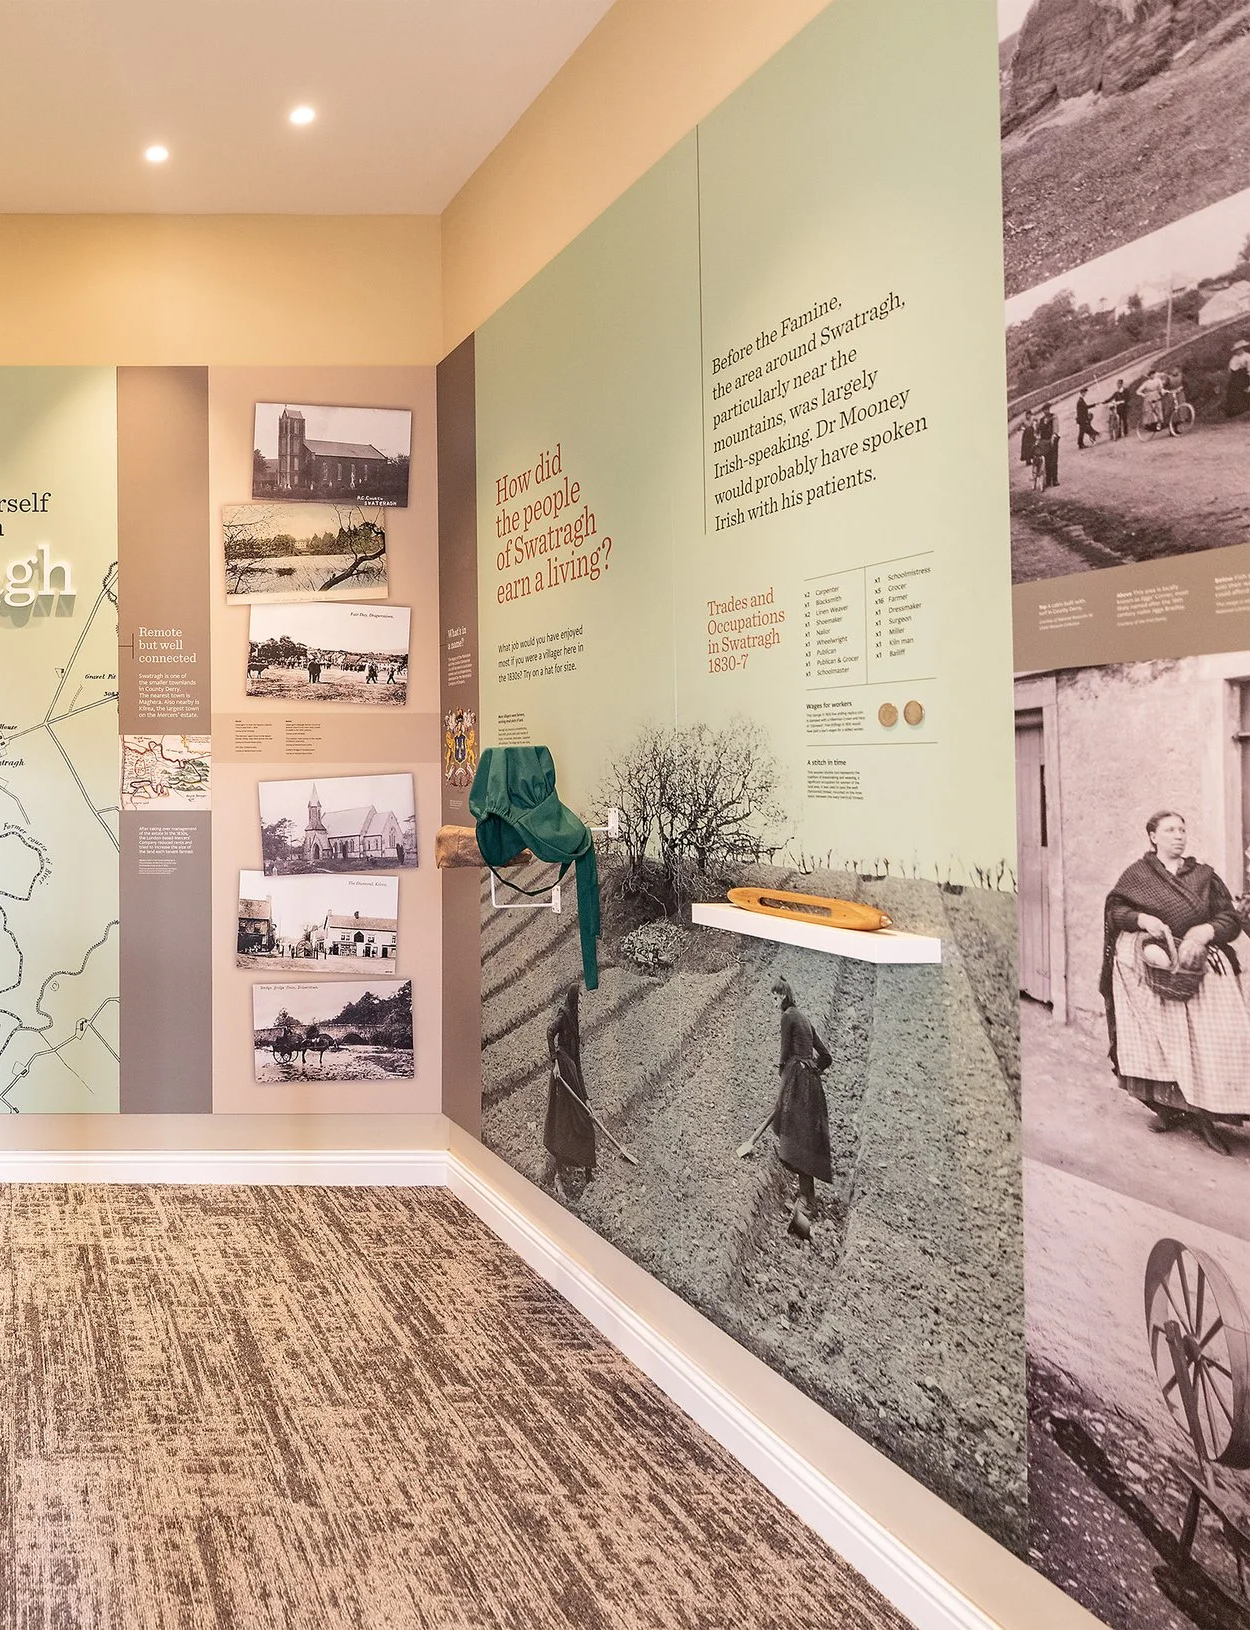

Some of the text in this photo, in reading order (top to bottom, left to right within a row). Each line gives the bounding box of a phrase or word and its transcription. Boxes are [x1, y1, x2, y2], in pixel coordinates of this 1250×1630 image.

[712, 296, 842, 376] Before the Famine,
[712, 292, 905, 400] the area around Swatragh,
[713, 349, 857, 431] particularly near the
[713, 370, 878, 454] mountains, was largely
[714, 389, 910, 480] Irish-speaking. Dr Mooney
[714, 417, 928, 505] would probably have spoken
[496, 443, 562, 506] How did
[715, 469, 876, 532] Irish with his patients.
[496, 477, 581, 538] the people
[496, 505, 597, 571] of Swatragh
[497, 536, 612, 604] earn a living?
[707, 586, 774, 617] Trades and
[139, 627, 182, 637] Remote
[139, 640, 183, 650] but well
[498, 624, 583, 653] What job would you have enjoyed
[707, 610, 785, 636] Occupations
[708, 627, 780, 656] in Swatragh
[139, 652, 196, 663] connected
[708, 653, 749, 674] 1830-7
